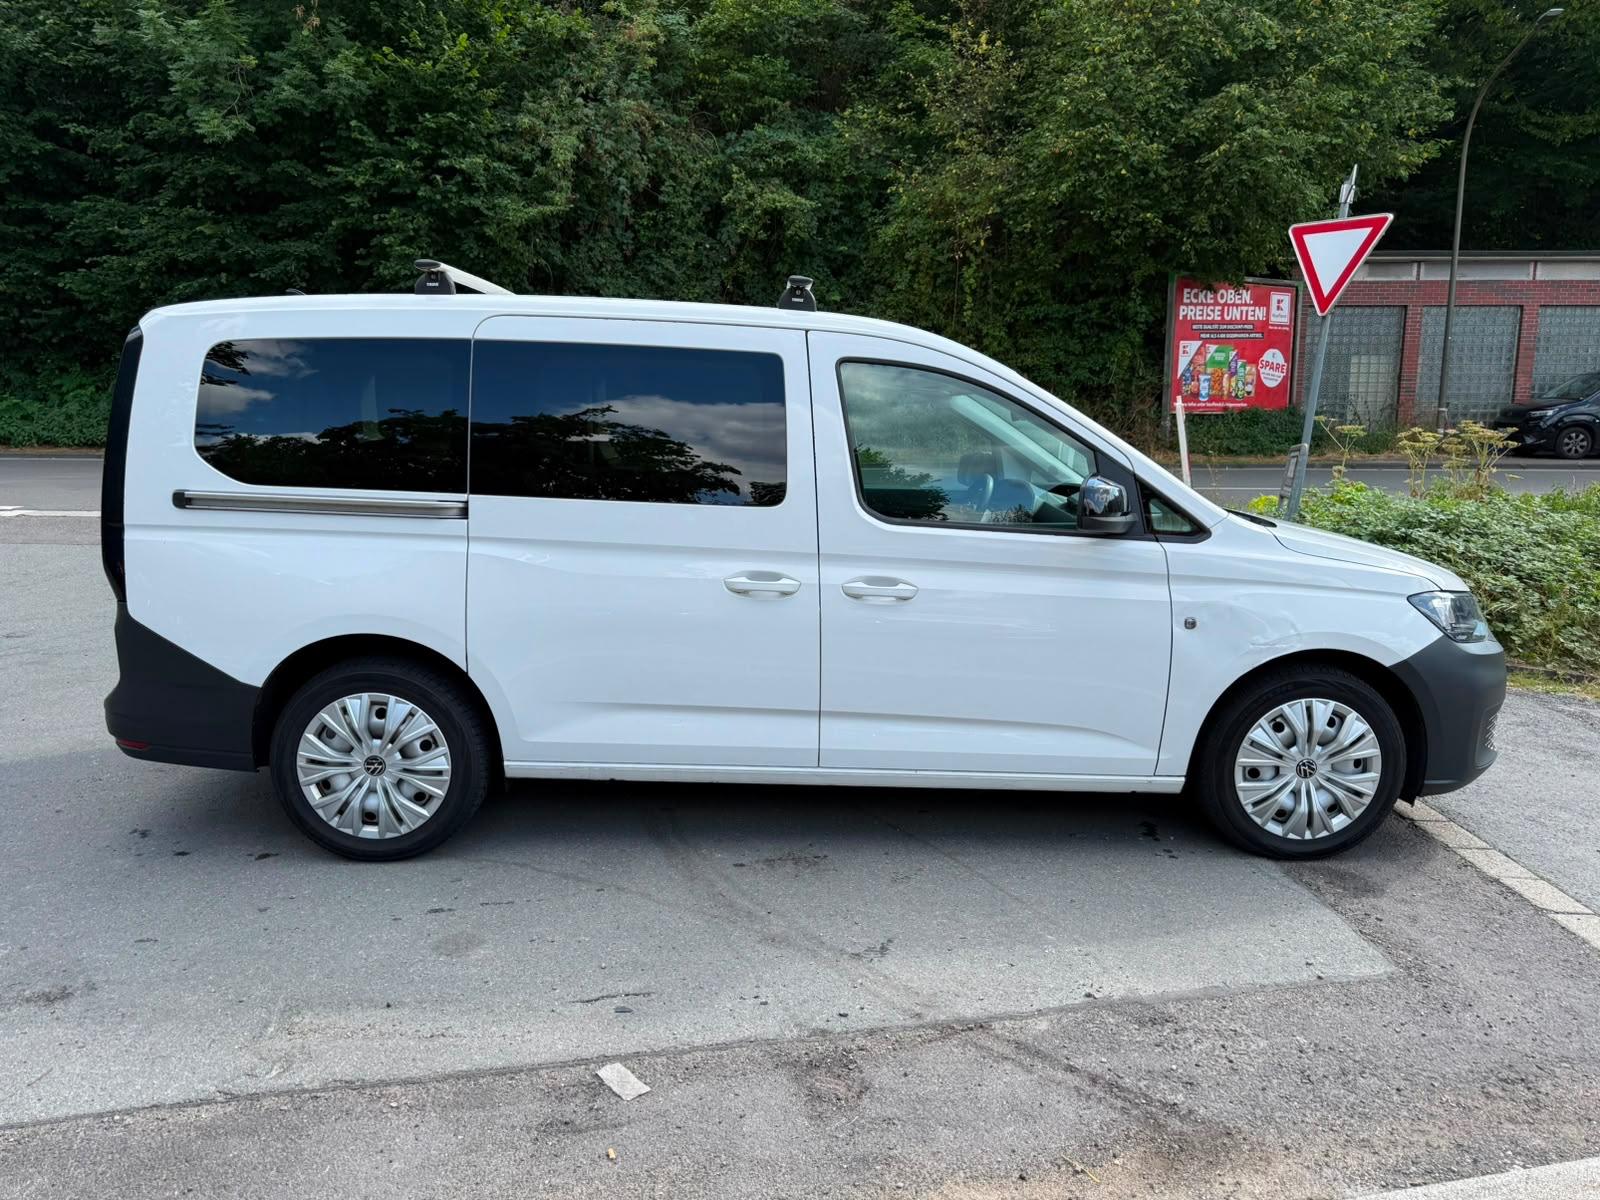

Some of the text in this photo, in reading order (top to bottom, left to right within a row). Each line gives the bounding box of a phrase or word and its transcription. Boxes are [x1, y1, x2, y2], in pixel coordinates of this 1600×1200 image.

[1183, 288, 1254, 304] ECKE OBEN.
[1179, 305, 1222, 320] PREISE
[1223, 306, 1267, 320] UNTEN!
[1259, 359, 1286, 374] SPARE
